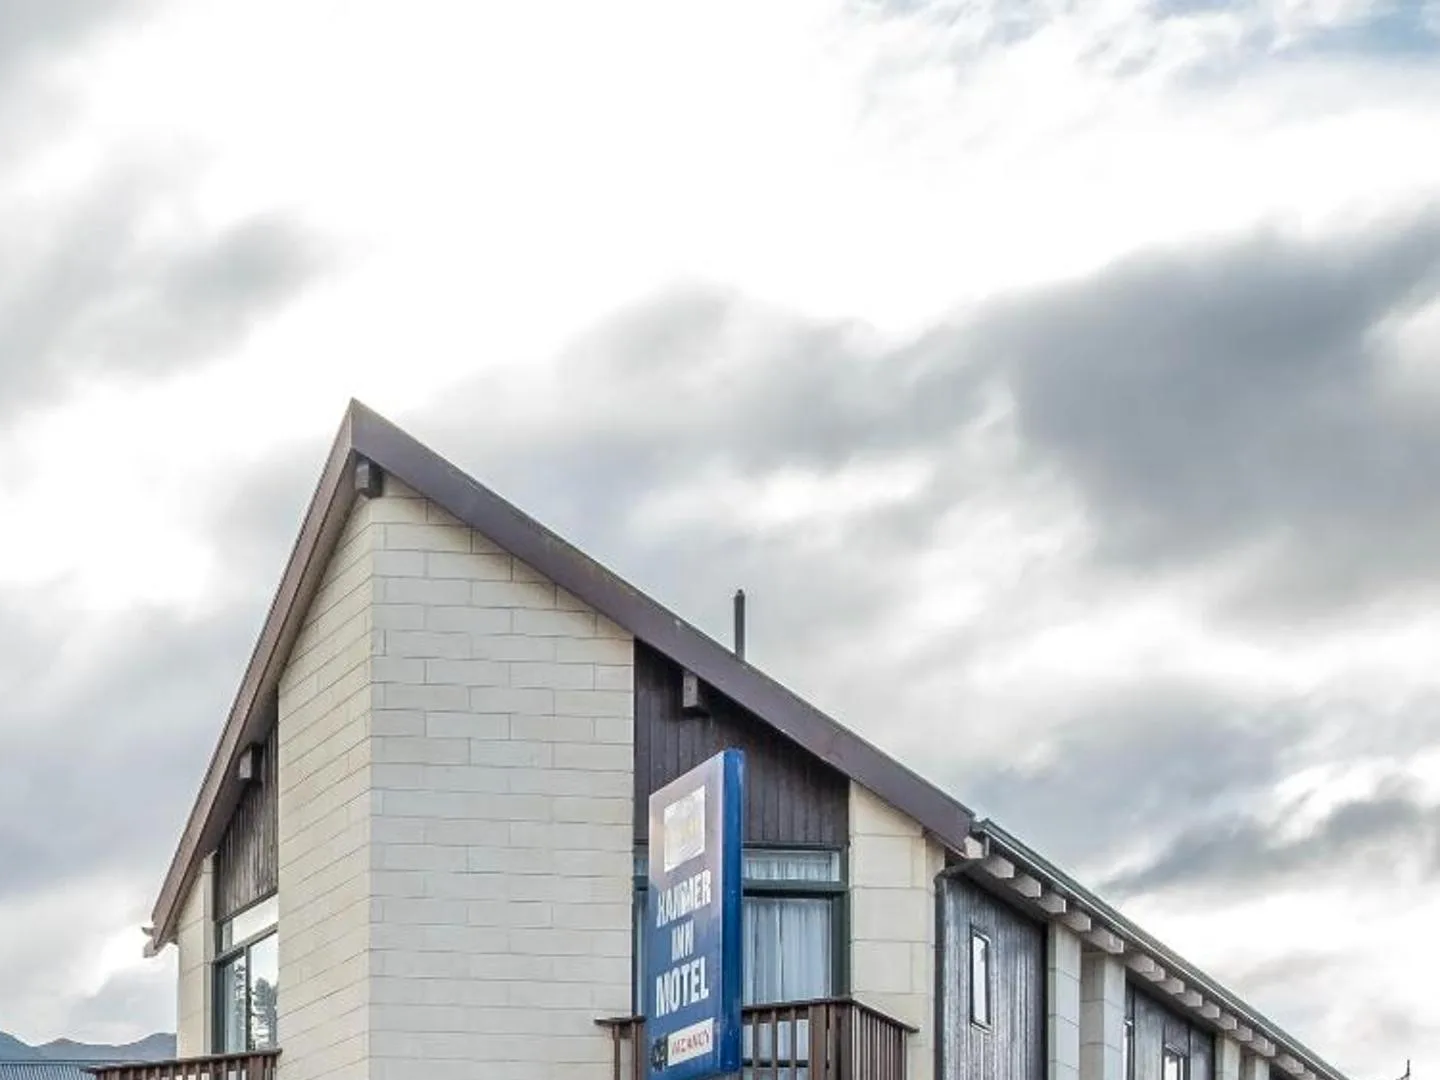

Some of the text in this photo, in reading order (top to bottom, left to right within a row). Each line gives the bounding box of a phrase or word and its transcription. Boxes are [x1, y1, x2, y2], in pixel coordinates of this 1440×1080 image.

[656, 868, 711, 929] HANMER
[672, 918, 694, 961] INN
[656, 957, 709, 1018] MOTEL
